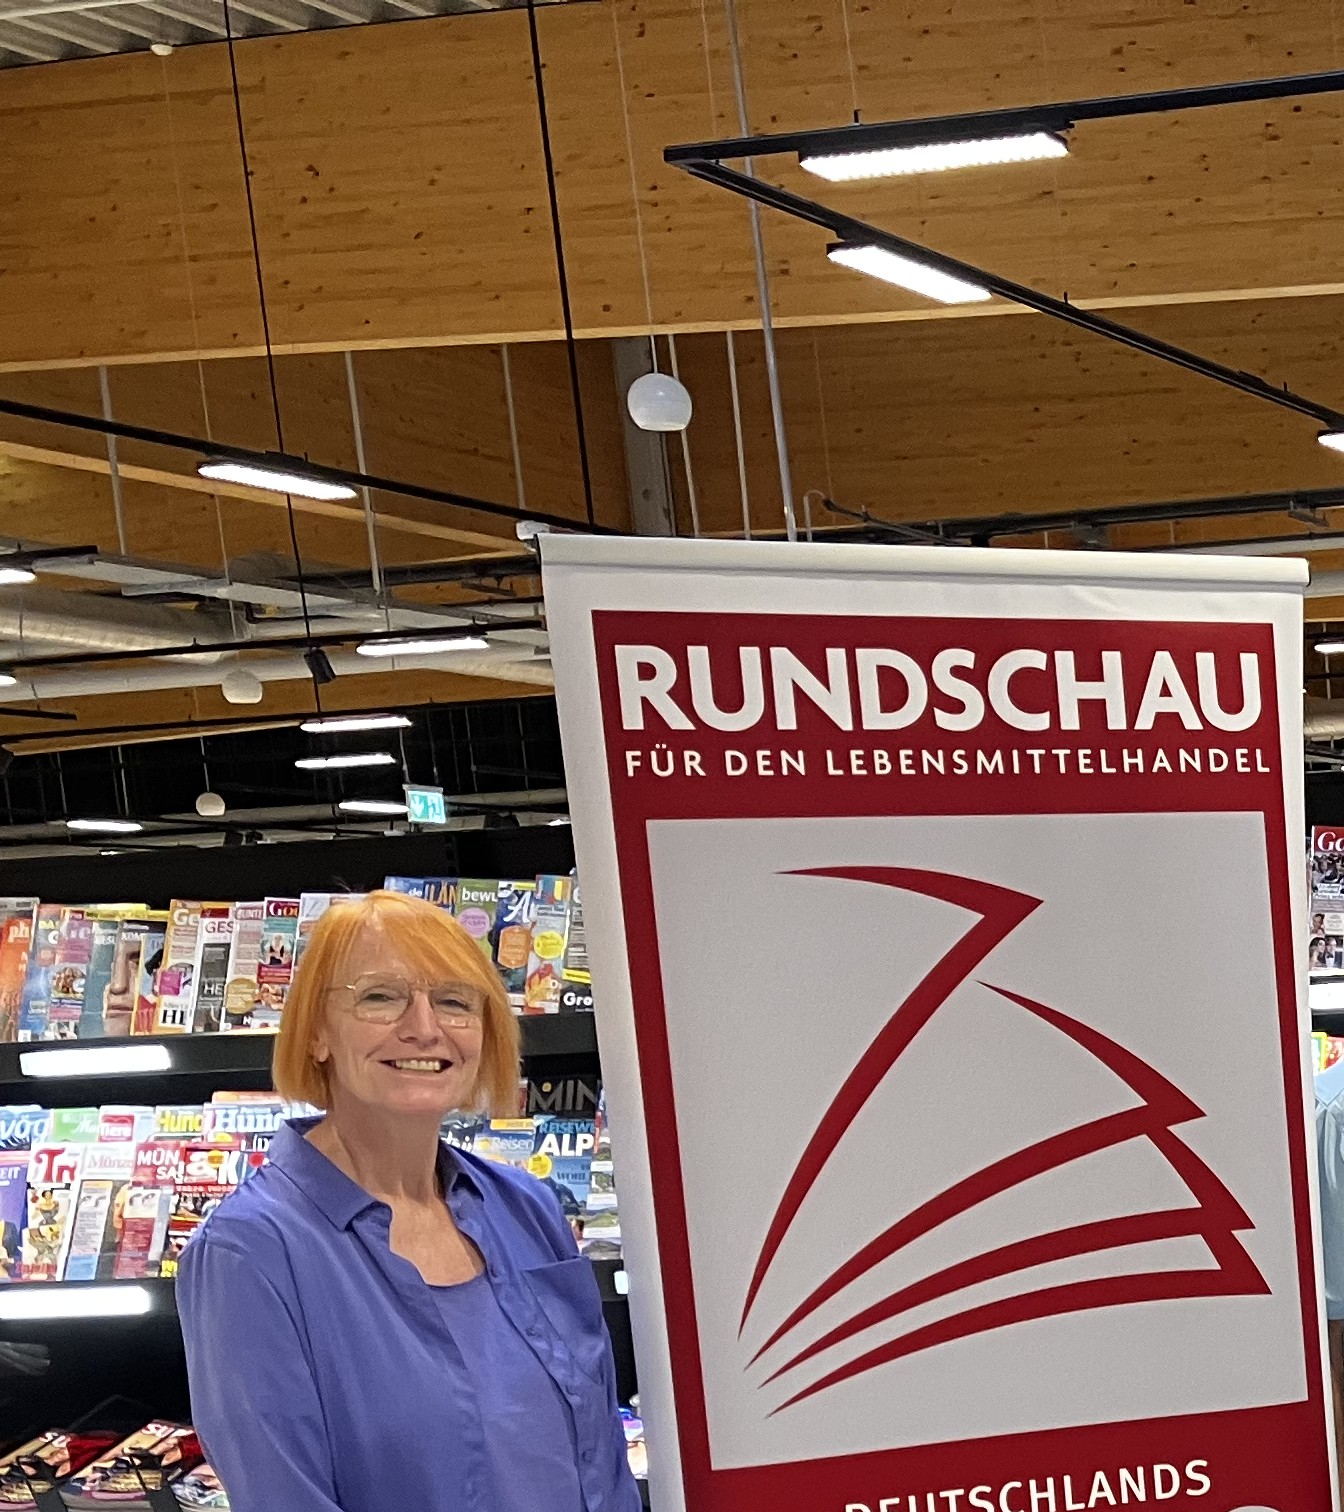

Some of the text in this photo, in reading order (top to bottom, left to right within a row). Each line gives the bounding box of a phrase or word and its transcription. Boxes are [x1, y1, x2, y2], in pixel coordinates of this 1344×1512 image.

[613, 643, 1262, 734] RUNDSCHAU
[626, 743, 1271, 778] FÜR DEN LEBENSMITTELHANDEL
